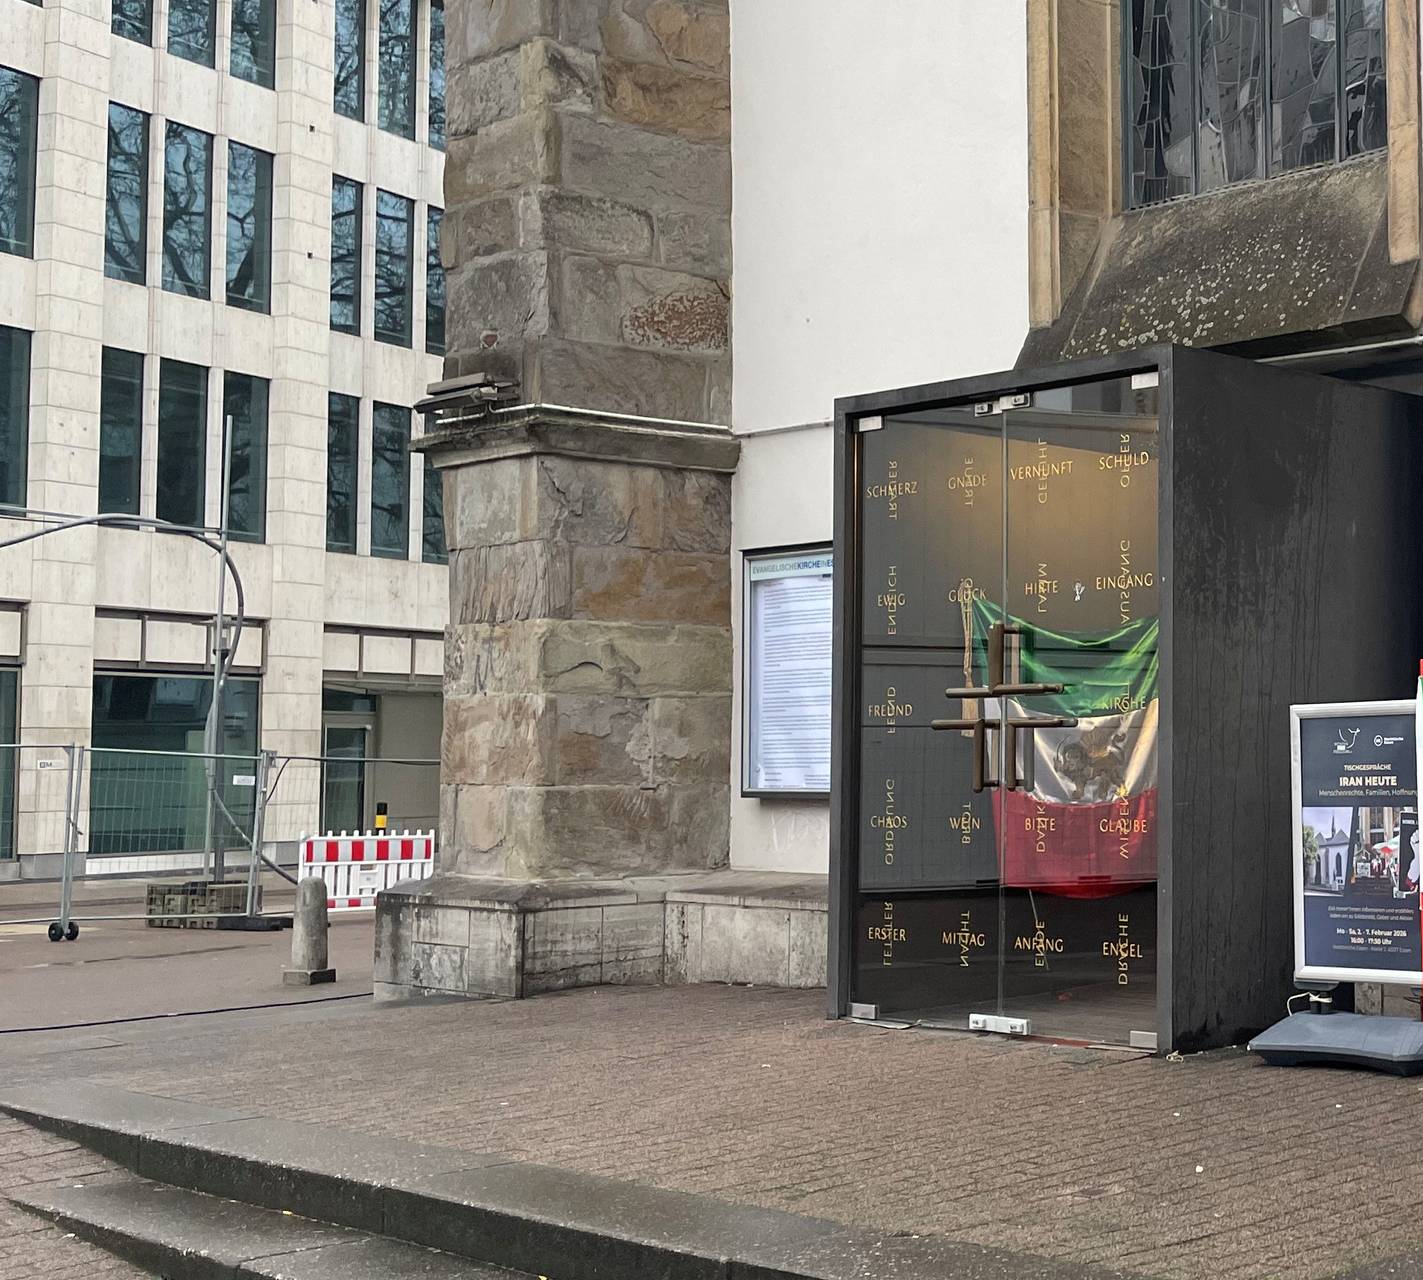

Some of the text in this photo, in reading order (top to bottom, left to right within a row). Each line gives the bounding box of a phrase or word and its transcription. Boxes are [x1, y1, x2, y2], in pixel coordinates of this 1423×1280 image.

[1098, 451, 1150, 470] SCHULD
[1010, 461, 1074, 480] VERNUNFT
[866, 481, 919, 498] SCHMERZ
[948, 474, 988, 490] GNADE
[1024, 580, 1059, 596] HIRTE
[1096, 573, 1153, 590] EINGANG
[877, 593, 906, 607] EWIG
[868, 704, 913, 717] FREUND
[1340, 776, 1397, 786] IRAN HEUTE
[870, 815, 908, 829] CHAOS
[949, 817, 981, 830] WEIN
[1024, 818, 1056, 832] BITTE
[1099, 818, 1148, 833] GLAUBE
[868, 927, 906, 942] ERSTER
[942, 931, 985, 947] MITTAG
[1014, 936, 1064, 953] ANFANG
[1102, 941, 1143, 958] ENGEL
